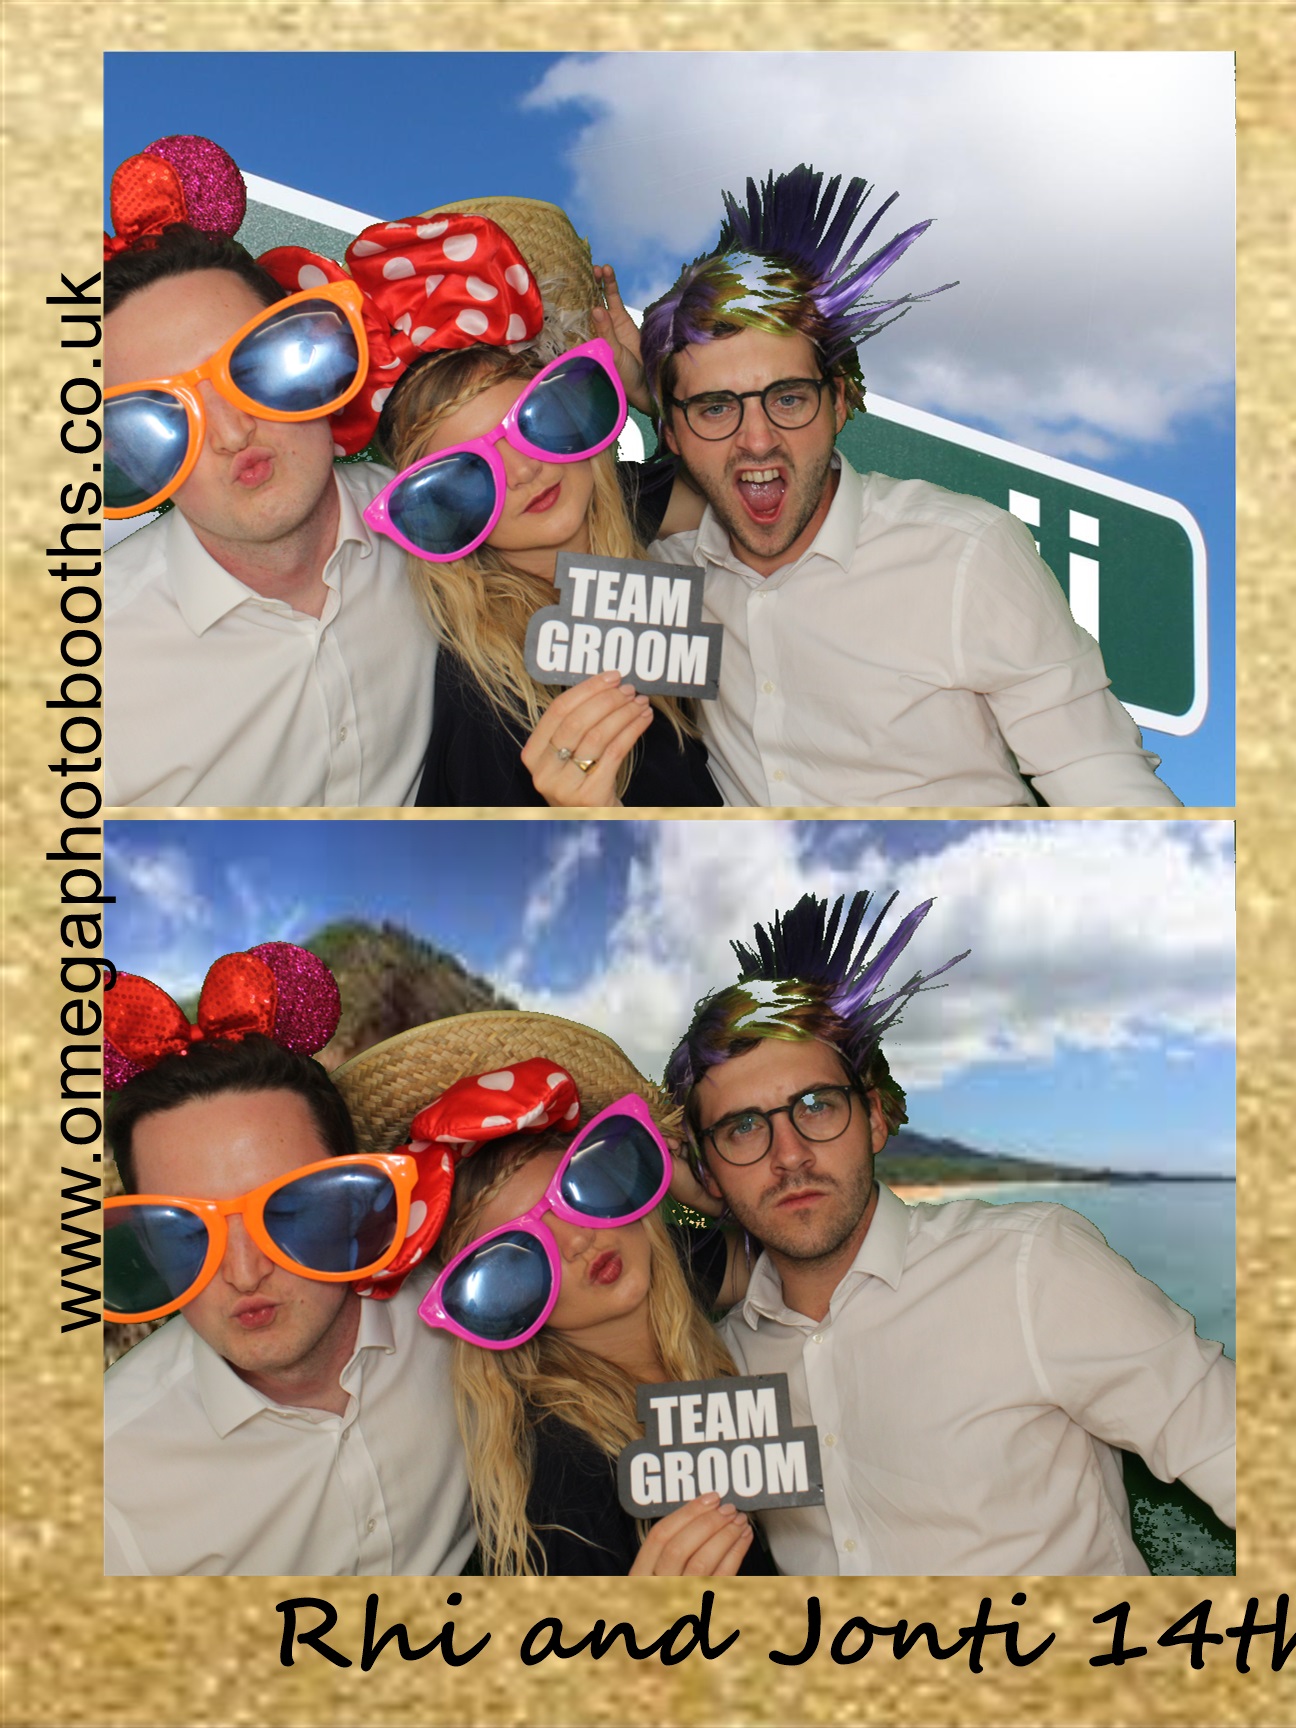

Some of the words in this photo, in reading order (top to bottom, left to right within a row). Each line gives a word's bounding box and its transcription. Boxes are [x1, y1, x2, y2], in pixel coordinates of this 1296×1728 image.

[568, 567, 692, 628] TEAM
[536, 620, 710, 686] GROOM
[650, 1387, 779, 1446] TEAM
[630, 1440, 809, 1506] GROOM
